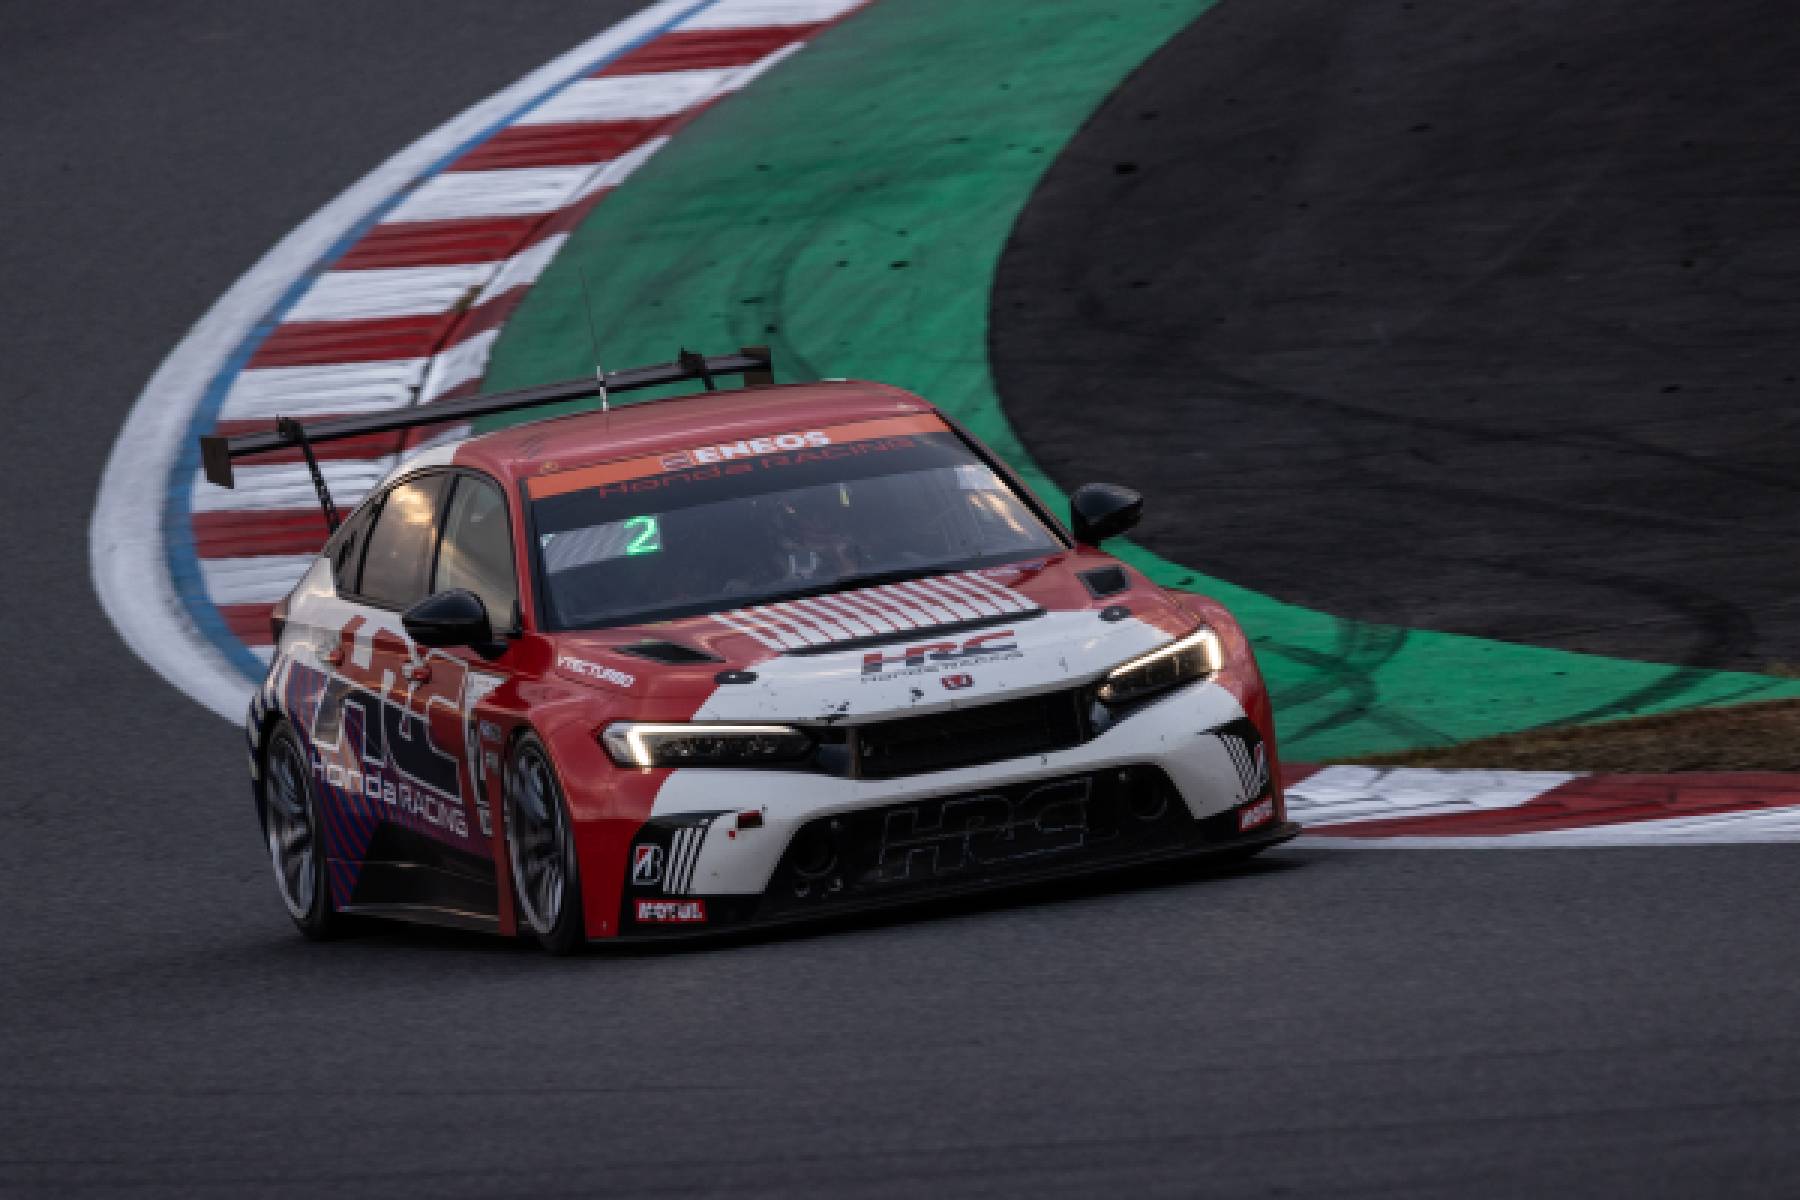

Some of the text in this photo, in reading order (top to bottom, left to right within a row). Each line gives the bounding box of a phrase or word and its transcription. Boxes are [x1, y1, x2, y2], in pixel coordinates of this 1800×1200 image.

[692, 431, 831, 464] ENEOS
[624, 516, 659, 555] 2
[861, 630, 1017, 675] HRC
[312, 755, 468, 837] Honda RACING
